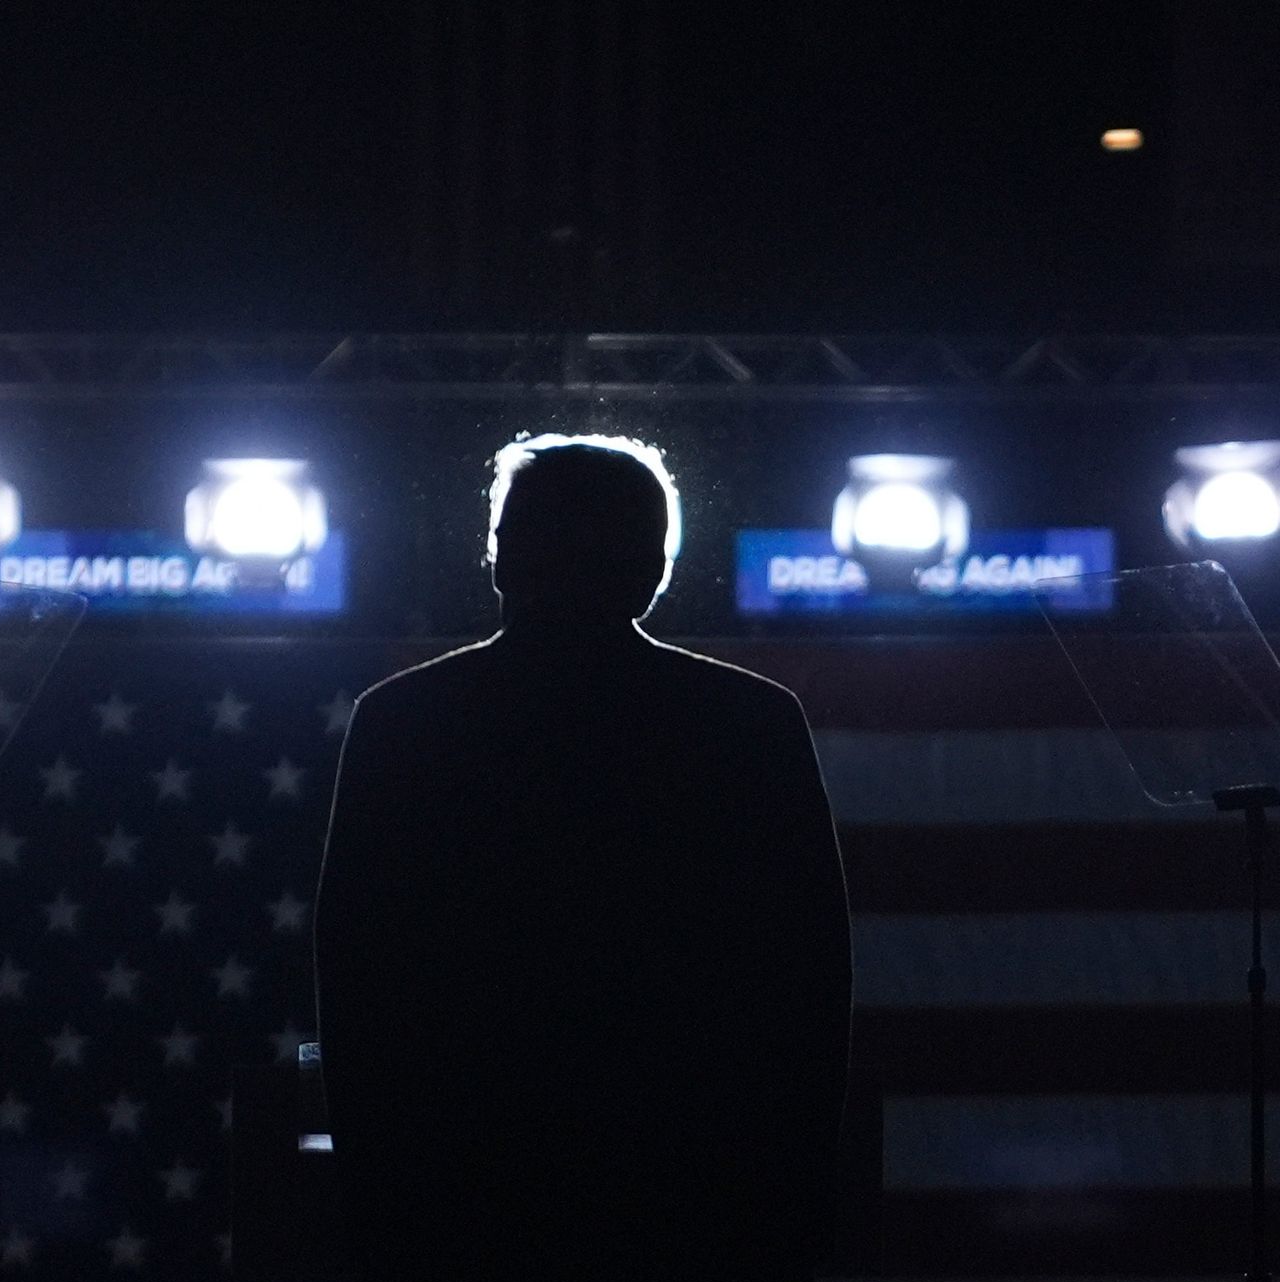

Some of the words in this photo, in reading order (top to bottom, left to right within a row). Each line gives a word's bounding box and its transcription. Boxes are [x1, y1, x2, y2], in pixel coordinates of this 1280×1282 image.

[0, 555, 122, 590] DREAM
[127, 555, 187, 590] BIG
[769, 555, 866, 589] DREA
